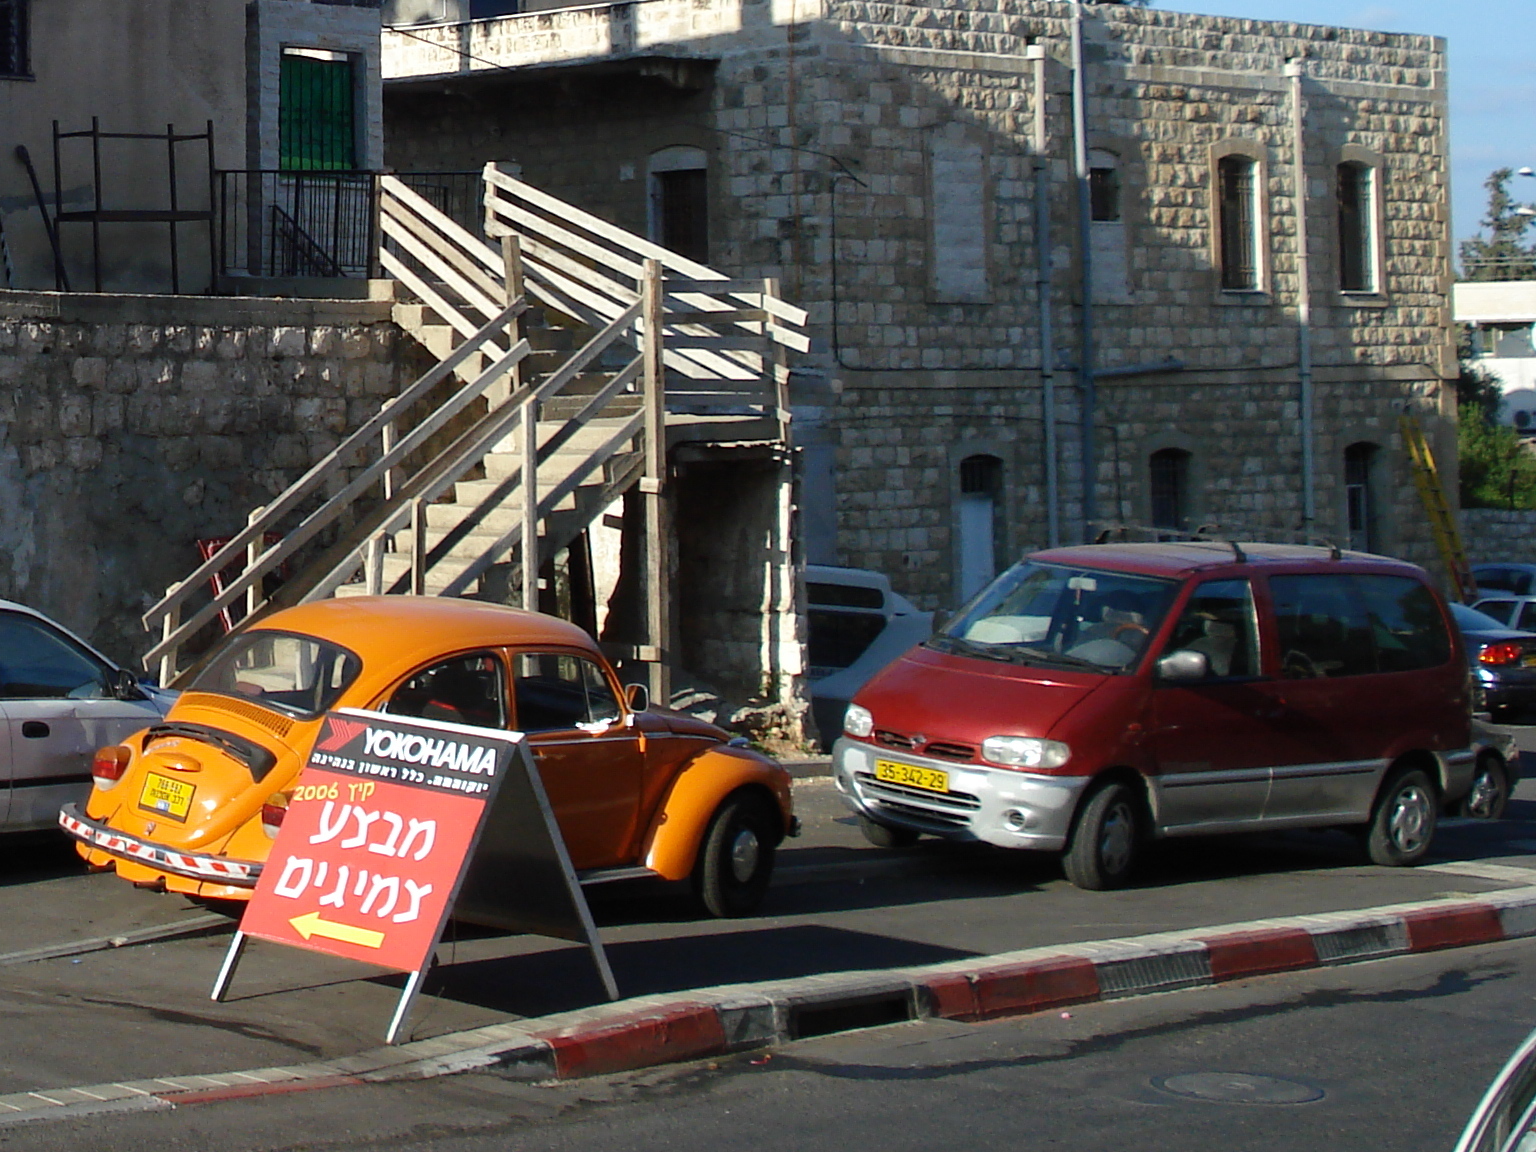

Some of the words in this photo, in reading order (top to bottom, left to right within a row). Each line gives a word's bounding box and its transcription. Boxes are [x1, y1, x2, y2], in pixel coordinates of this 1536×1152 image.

[311, 752, 356, 771] בנהיגה
[364, 727, 497, 776] YOKOHAMA
[357, 762, 398, 779] ראשון
[400, 768, 425, 784] כלל
[880, 762, 945, 789] 35-342-29
[293, 783, 339, 801] 2006
[348, 782, 375, 802] קיץ
[309, 801, 437, 862] מבצע
[273, 855, 433, 923] צמיגים
